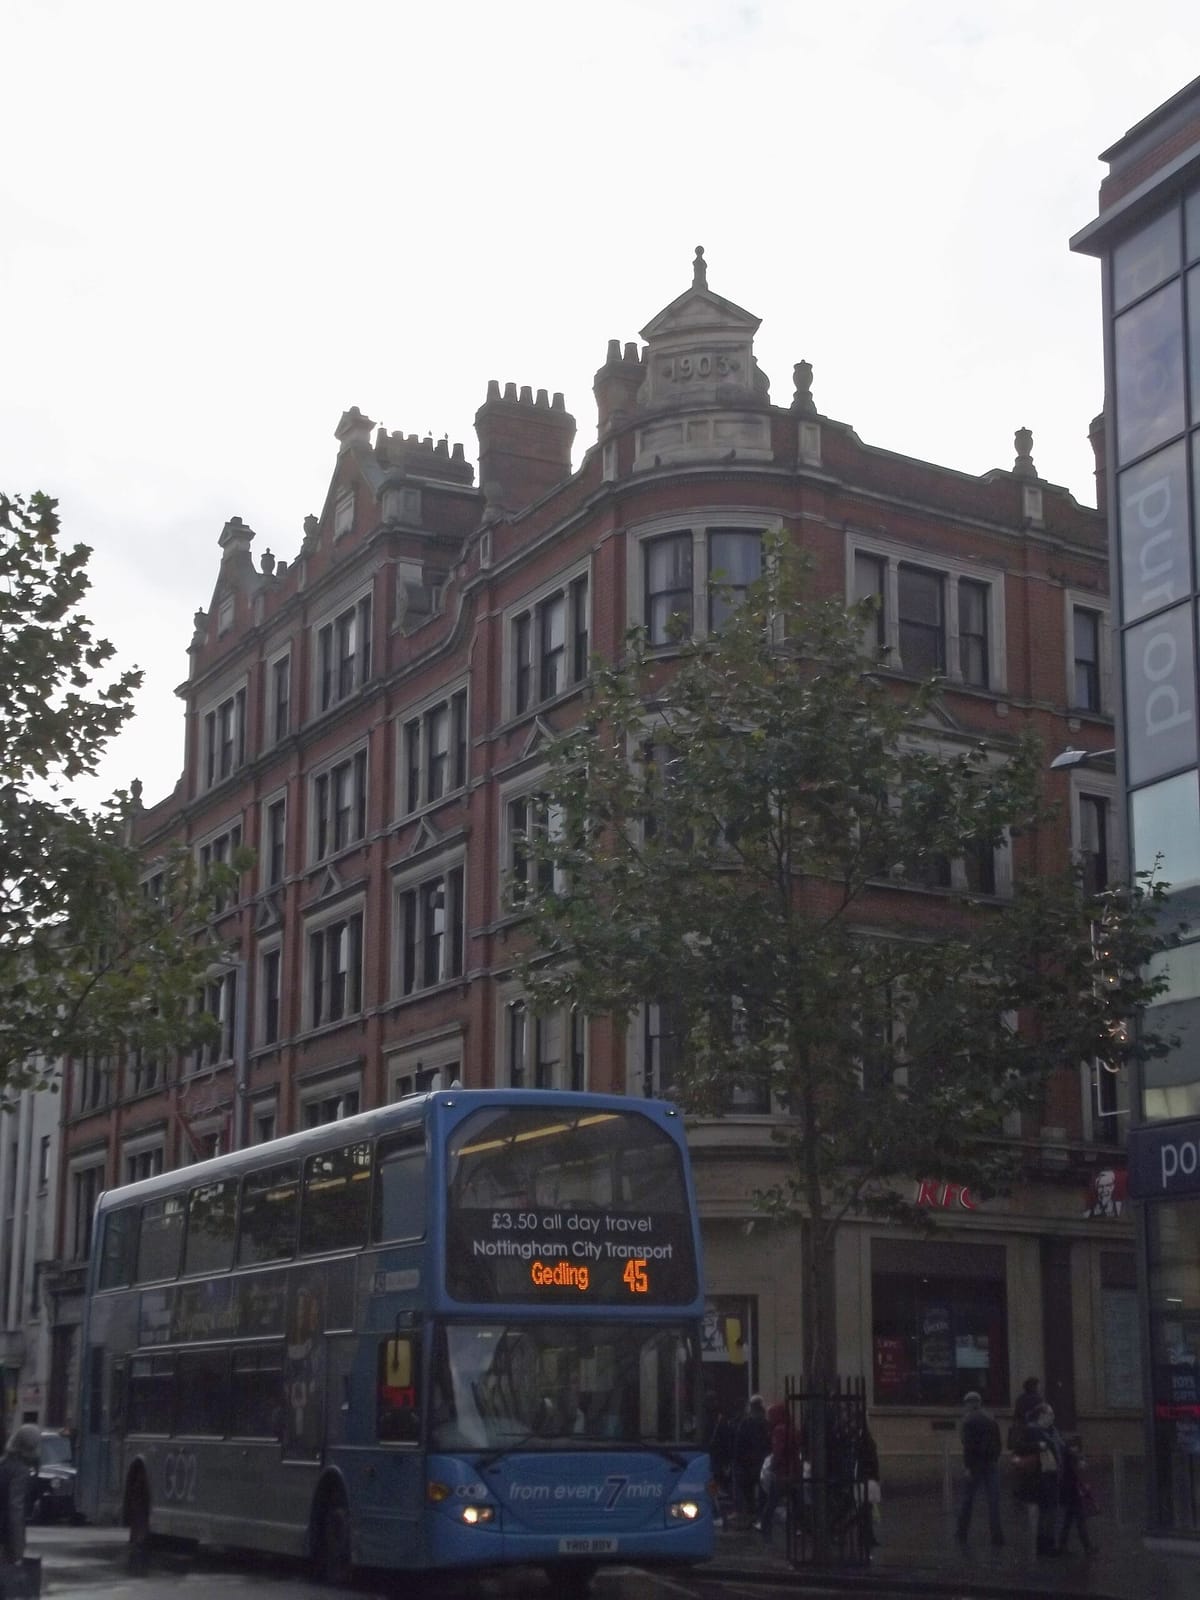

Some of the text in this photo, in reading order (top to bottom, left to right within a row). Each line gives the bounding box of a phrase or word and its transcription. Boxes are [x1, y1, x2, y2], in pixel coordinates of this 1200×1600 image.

[1160, 1138, 1200, 1189] po
[491, 1213, 652, 1233] £3.50 all day travel
[473, 1240, 673, 1261] Nottingham City Transport
[531, 1260, 649, 1292] Gedling 45
[509, 1474, 663, 1512] from every 7 mins
